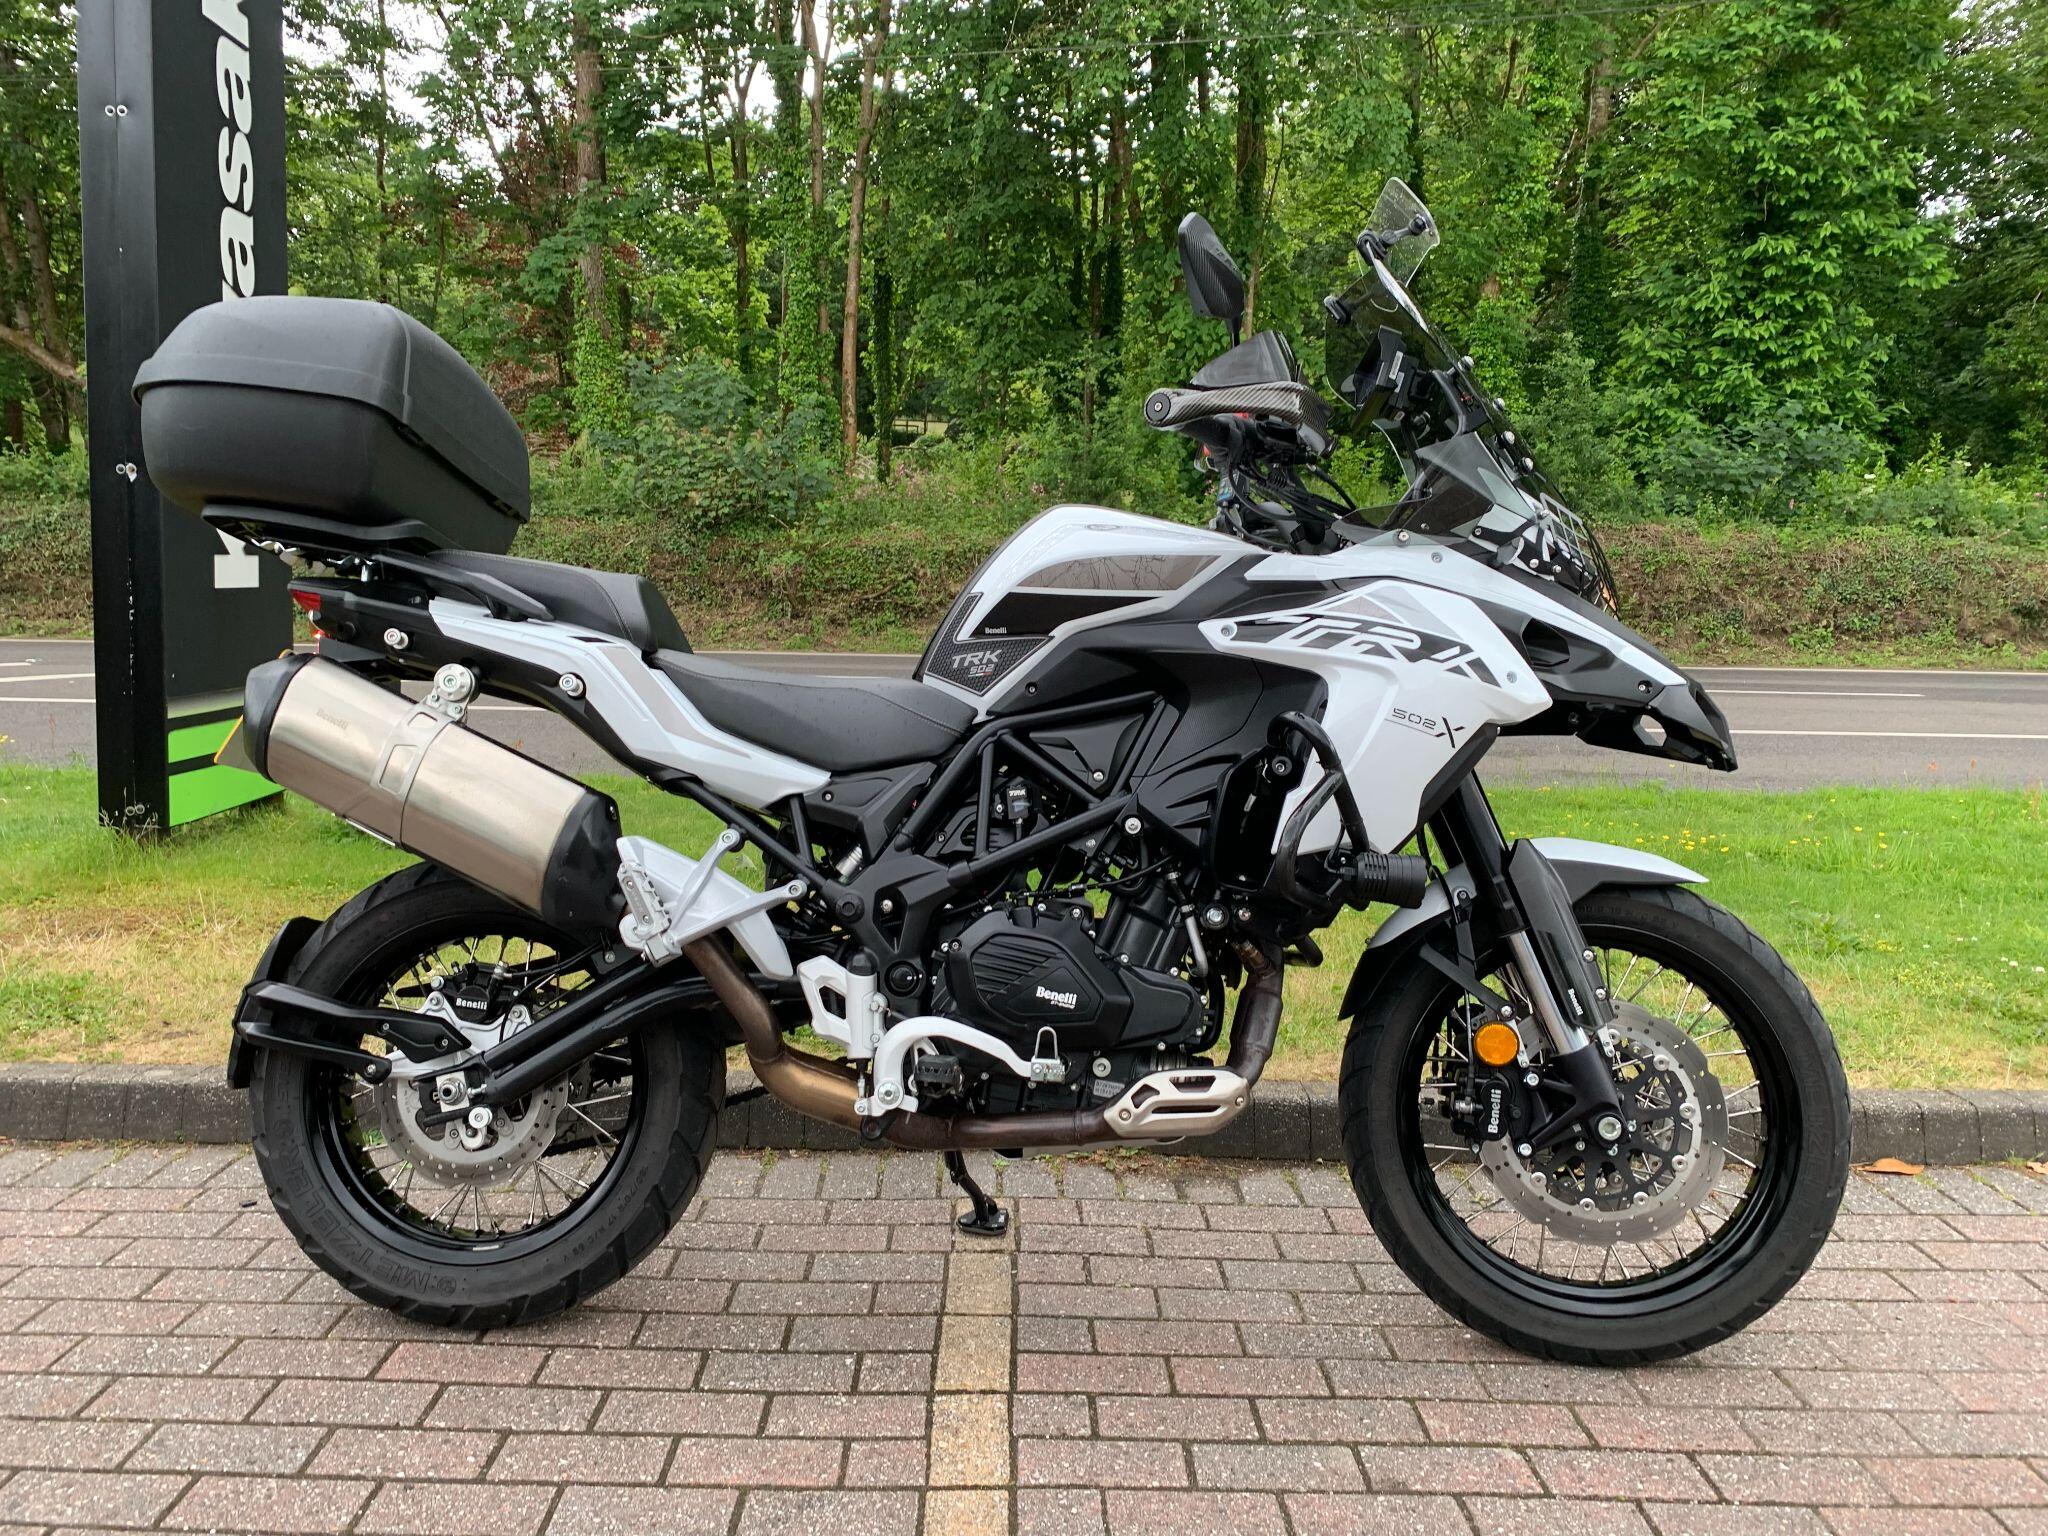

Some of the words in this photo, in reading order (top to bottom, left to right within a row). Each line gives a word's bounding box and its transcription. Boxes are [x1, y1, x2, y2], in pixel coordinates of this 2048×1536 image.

[984, 626, 1007, 634] Benelli
[952, 649, 1002, 668] TRK
[455, 997, 488, 1010] Benelli
[1035, 985, 1077, 1005] Benelli
[1487, 1088, 1502, 1134] Benelli
